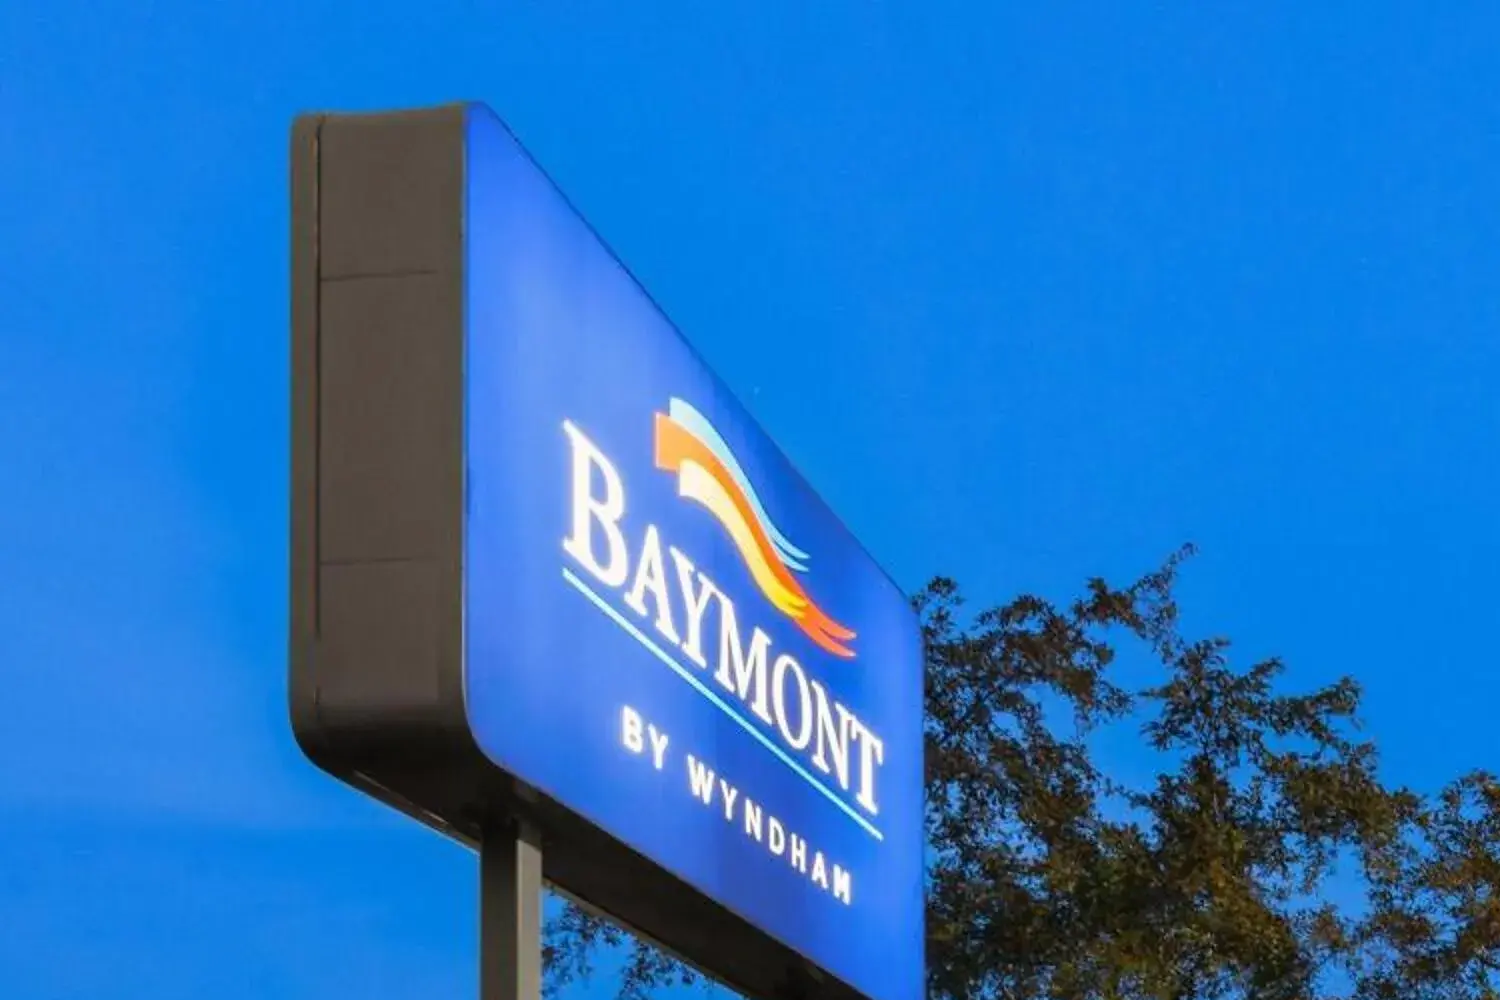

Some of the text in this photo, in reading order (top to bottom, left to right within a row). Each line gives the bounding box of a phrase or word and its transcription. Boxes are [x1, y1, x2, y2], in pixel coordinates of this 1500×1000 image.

[562, 419, 884, 814] BAYMONT
[621, 705, 851, 904] BY WYNDHAM
